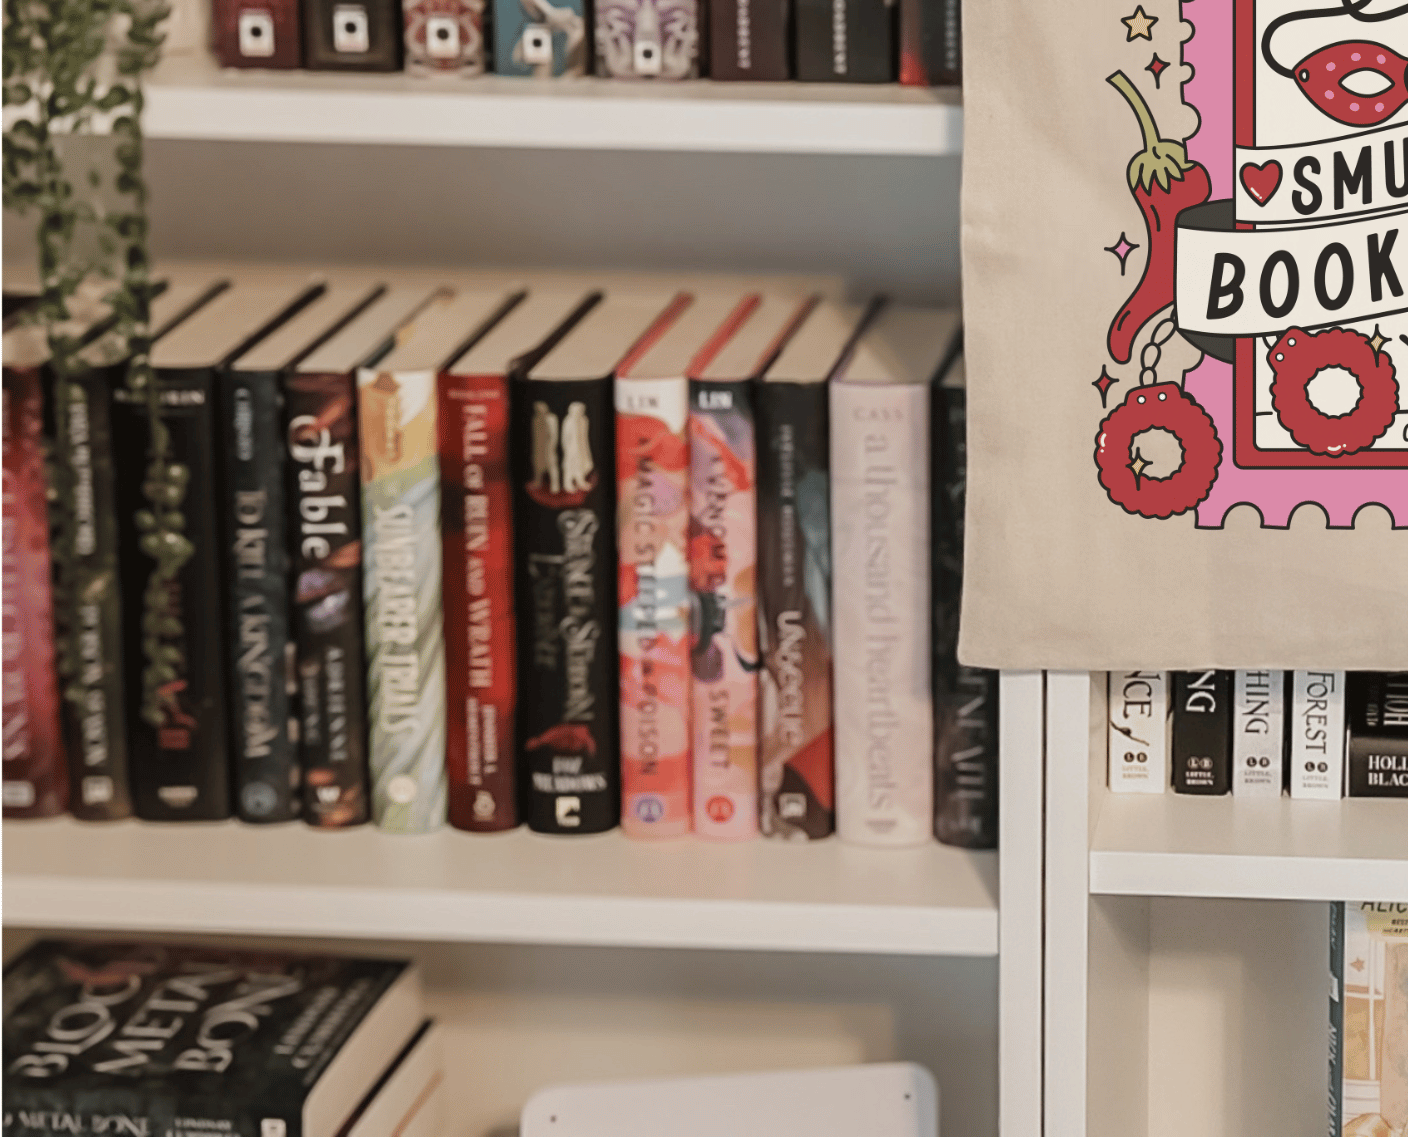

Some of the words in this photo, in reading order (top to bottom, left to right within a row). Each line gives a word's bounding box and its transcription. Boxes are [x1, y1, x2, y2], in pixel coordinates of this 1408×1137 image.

[1206, 228, 1405, 321] BOOK
[462, 403, 489, 461] FALL
[625, 393, 658, 410] LIN
[698, 389, 733, 410] LIN
[289, 415, 349, 562] Fable
[467, 597, 495, 689] WRATH
[1301, 671, 1336, 755] FOREST
